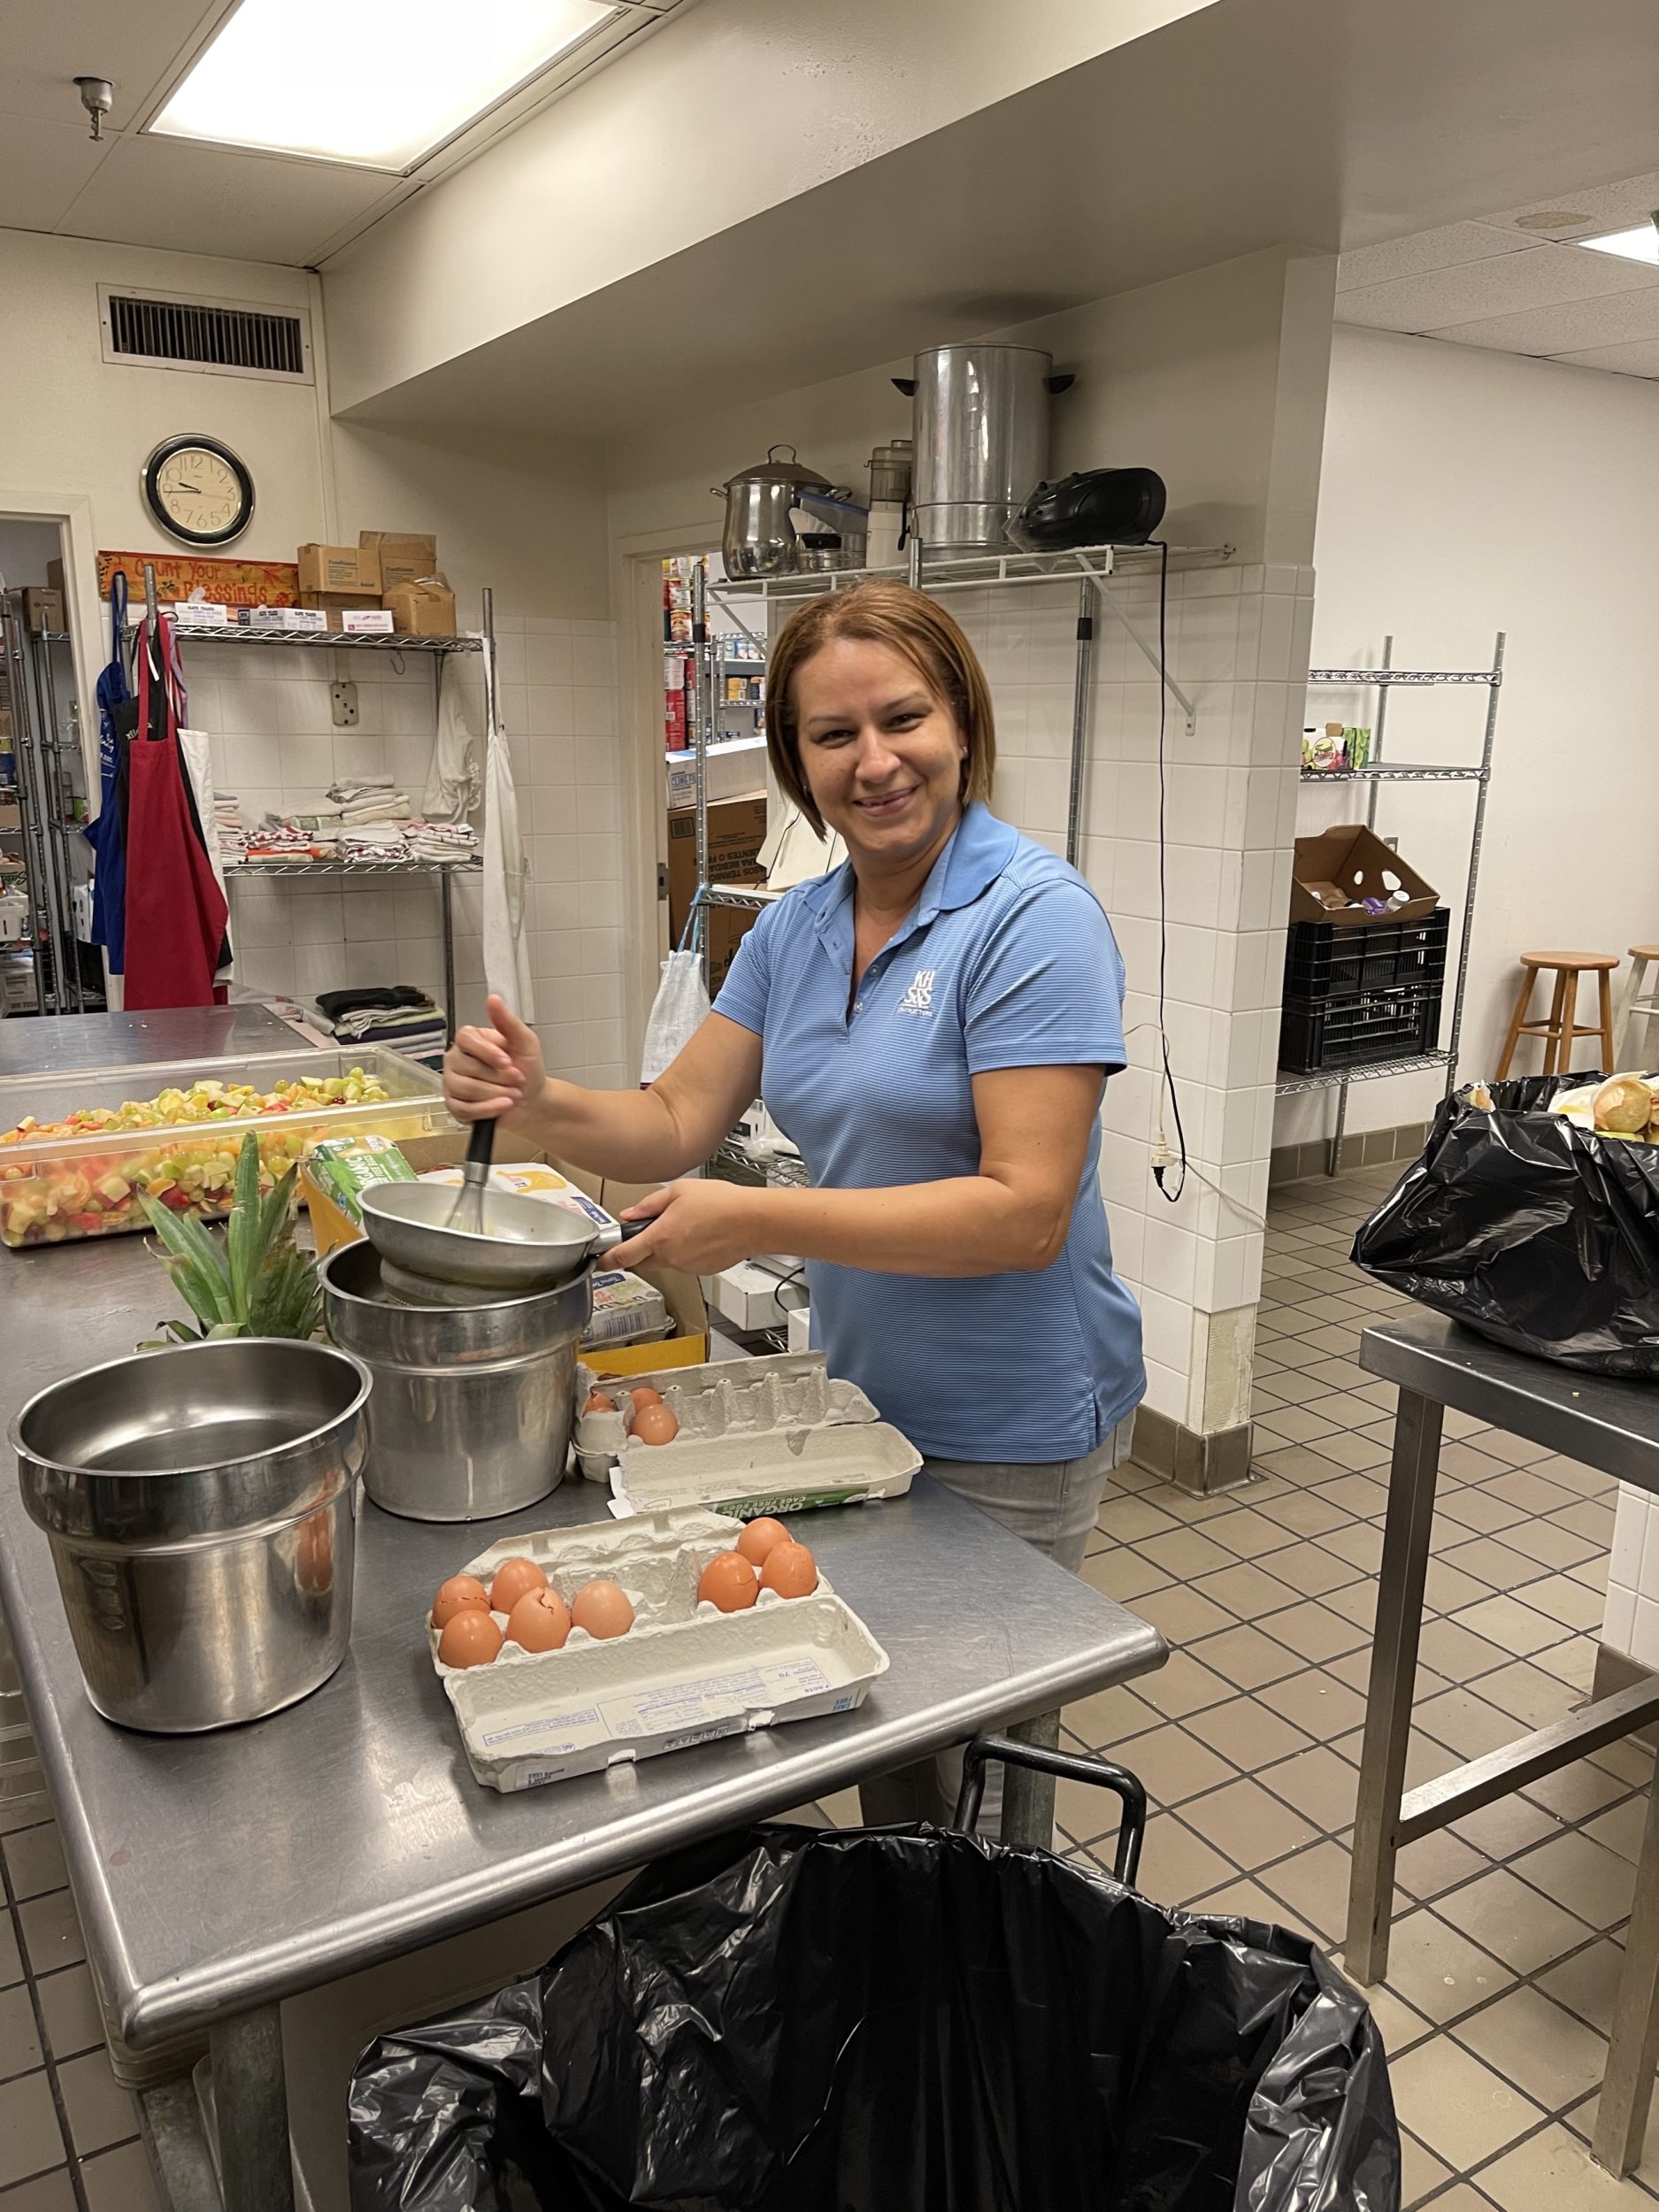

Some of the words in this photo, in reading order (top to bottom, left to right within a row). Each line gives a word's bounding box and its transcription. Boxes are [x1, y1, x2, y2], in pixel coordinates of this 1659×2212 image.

[180, 456, 188, 472] 11
[190, 455, 204, 469] 12
[209, 458, 213, 473] 1
[165, 466, 182, 483] 10
[217, 469, 228, 484] 2
[162, 482, 173, 498] 9
[226, 486, 236, 502] 3
[170, 498, 180, 514] 8
[220, 502, 231, 518] 4
[183, 509, 194, 524] 7
[196, 513, 207, 529] 6
[210, 511, 221, 526] 5
[134, 558, 182, 577] Cunt
[188, 562, 221, 579] Your
[708, 860, 740, 872] BEBIDA
[741, 857, 757, 866] ARA
[914, 970, 935, 987] KH
[721, 1502, 803, 1518] ORGANIC
[723, 1502, 749, 1510] EGGS
